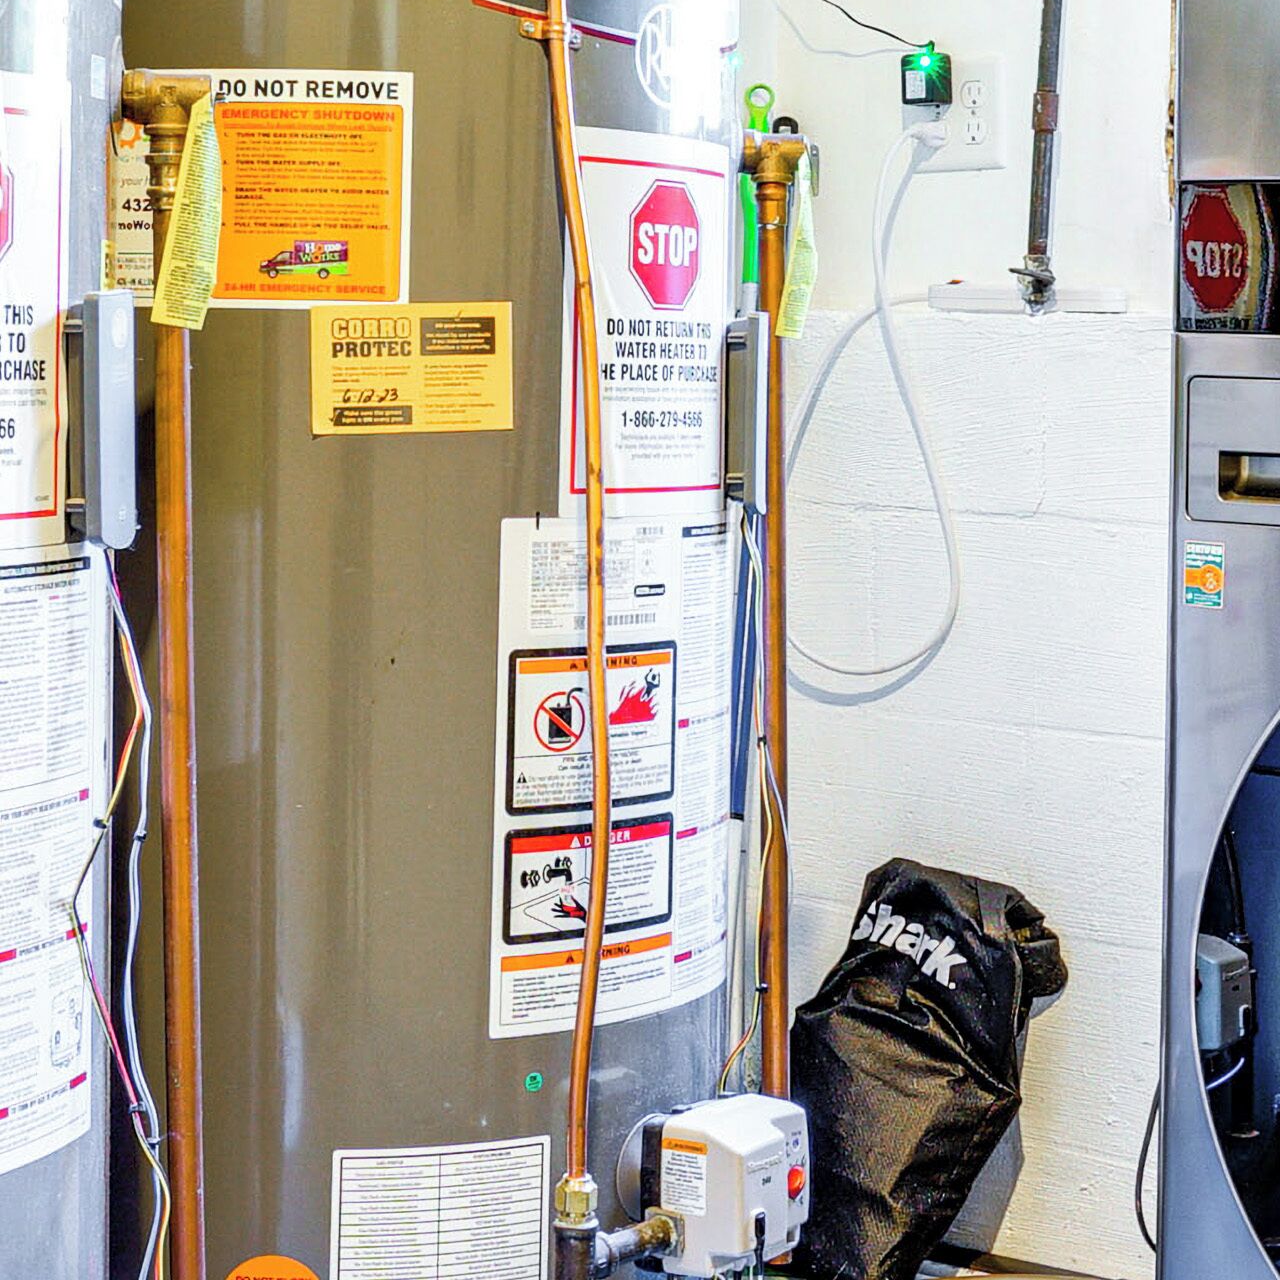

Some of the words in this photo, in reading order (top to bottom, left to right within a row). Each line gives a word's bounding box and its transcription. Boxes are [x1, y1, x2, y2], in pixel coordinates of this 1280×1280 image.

[219, 79, 246, 96] DO
[254, 80, 298, 97] NOT
[306, 81, 399, 100] REMOVE
[221, 108, 308, 119] EMERGENCY
[313, 110, 395, 122] SHUTDOWN
[638, 222, 697, 266] STOP
[260, 284, 331, 293] EMERGENCY
[336, 286, 386, 295] SERVICE
[4, 304, 34, 326] THIS
[331, 317, 412, 340] CORRO
[607, 318, 624, 335] DO
[629, 319, 652, 336] NOT
[9, 332, 26, 353] TO
[332, 341, 412, 358] PROTEC
[615, 341, 656, 359] WATER
[600, 363, 616, 380] HE
[621, 364, 658, 381] PLACE
[662, 365, 674, 381] OF
[584, 830, 630, 846] DGER
[601, 945, 630, 961] RNING
